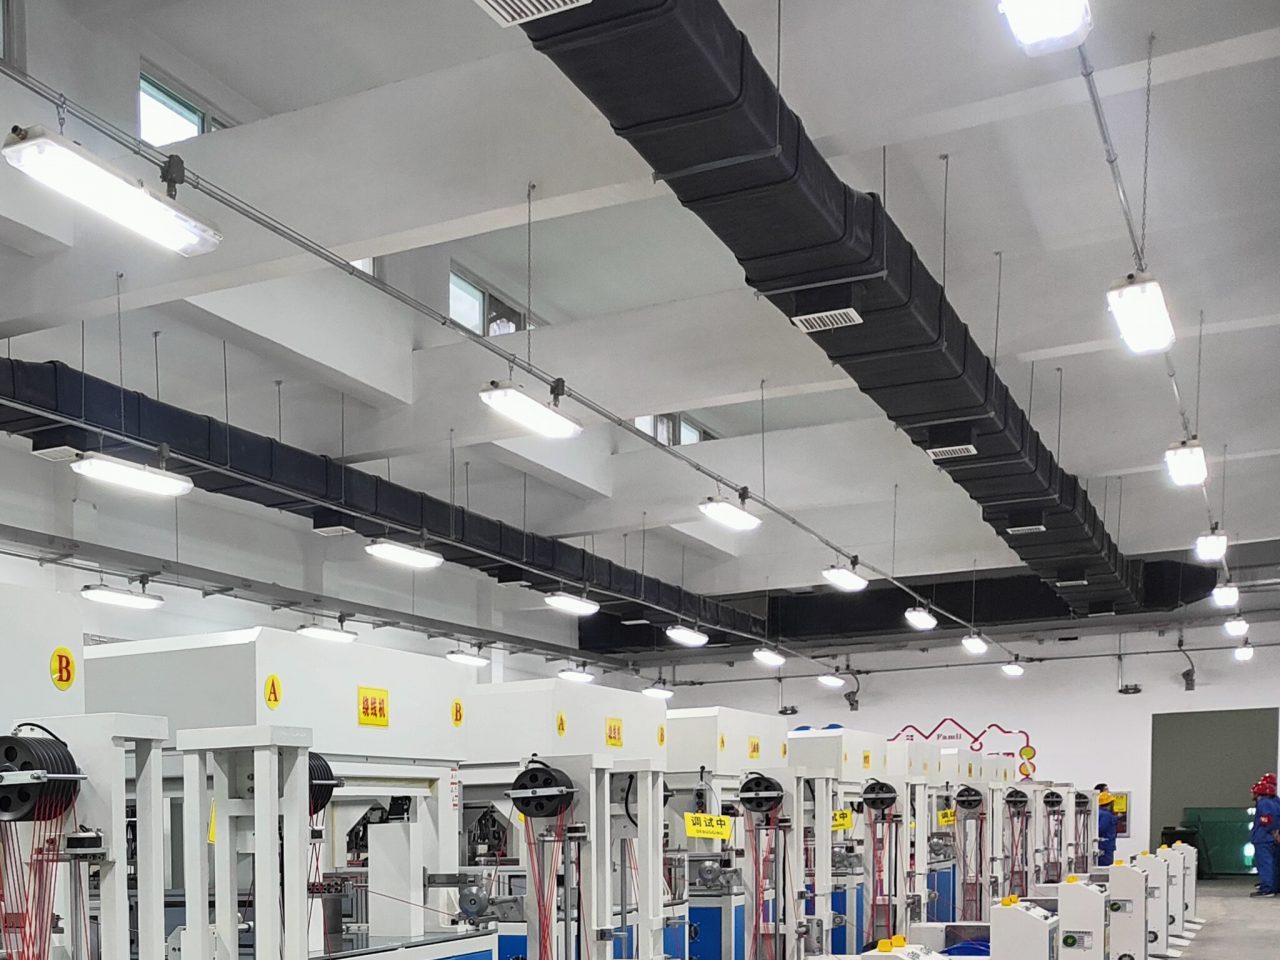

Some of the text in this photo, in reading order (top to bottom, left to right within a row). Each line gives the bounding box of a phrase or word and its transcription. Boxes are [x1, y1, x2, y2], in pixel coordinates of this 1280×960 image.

[56, 654, 71, 682] B
[267, 678, 279, 702] A
[454, 702, 462, 722] B
[557, 714, 565, 731] A
[691, 816, 726, 828] 调试中
